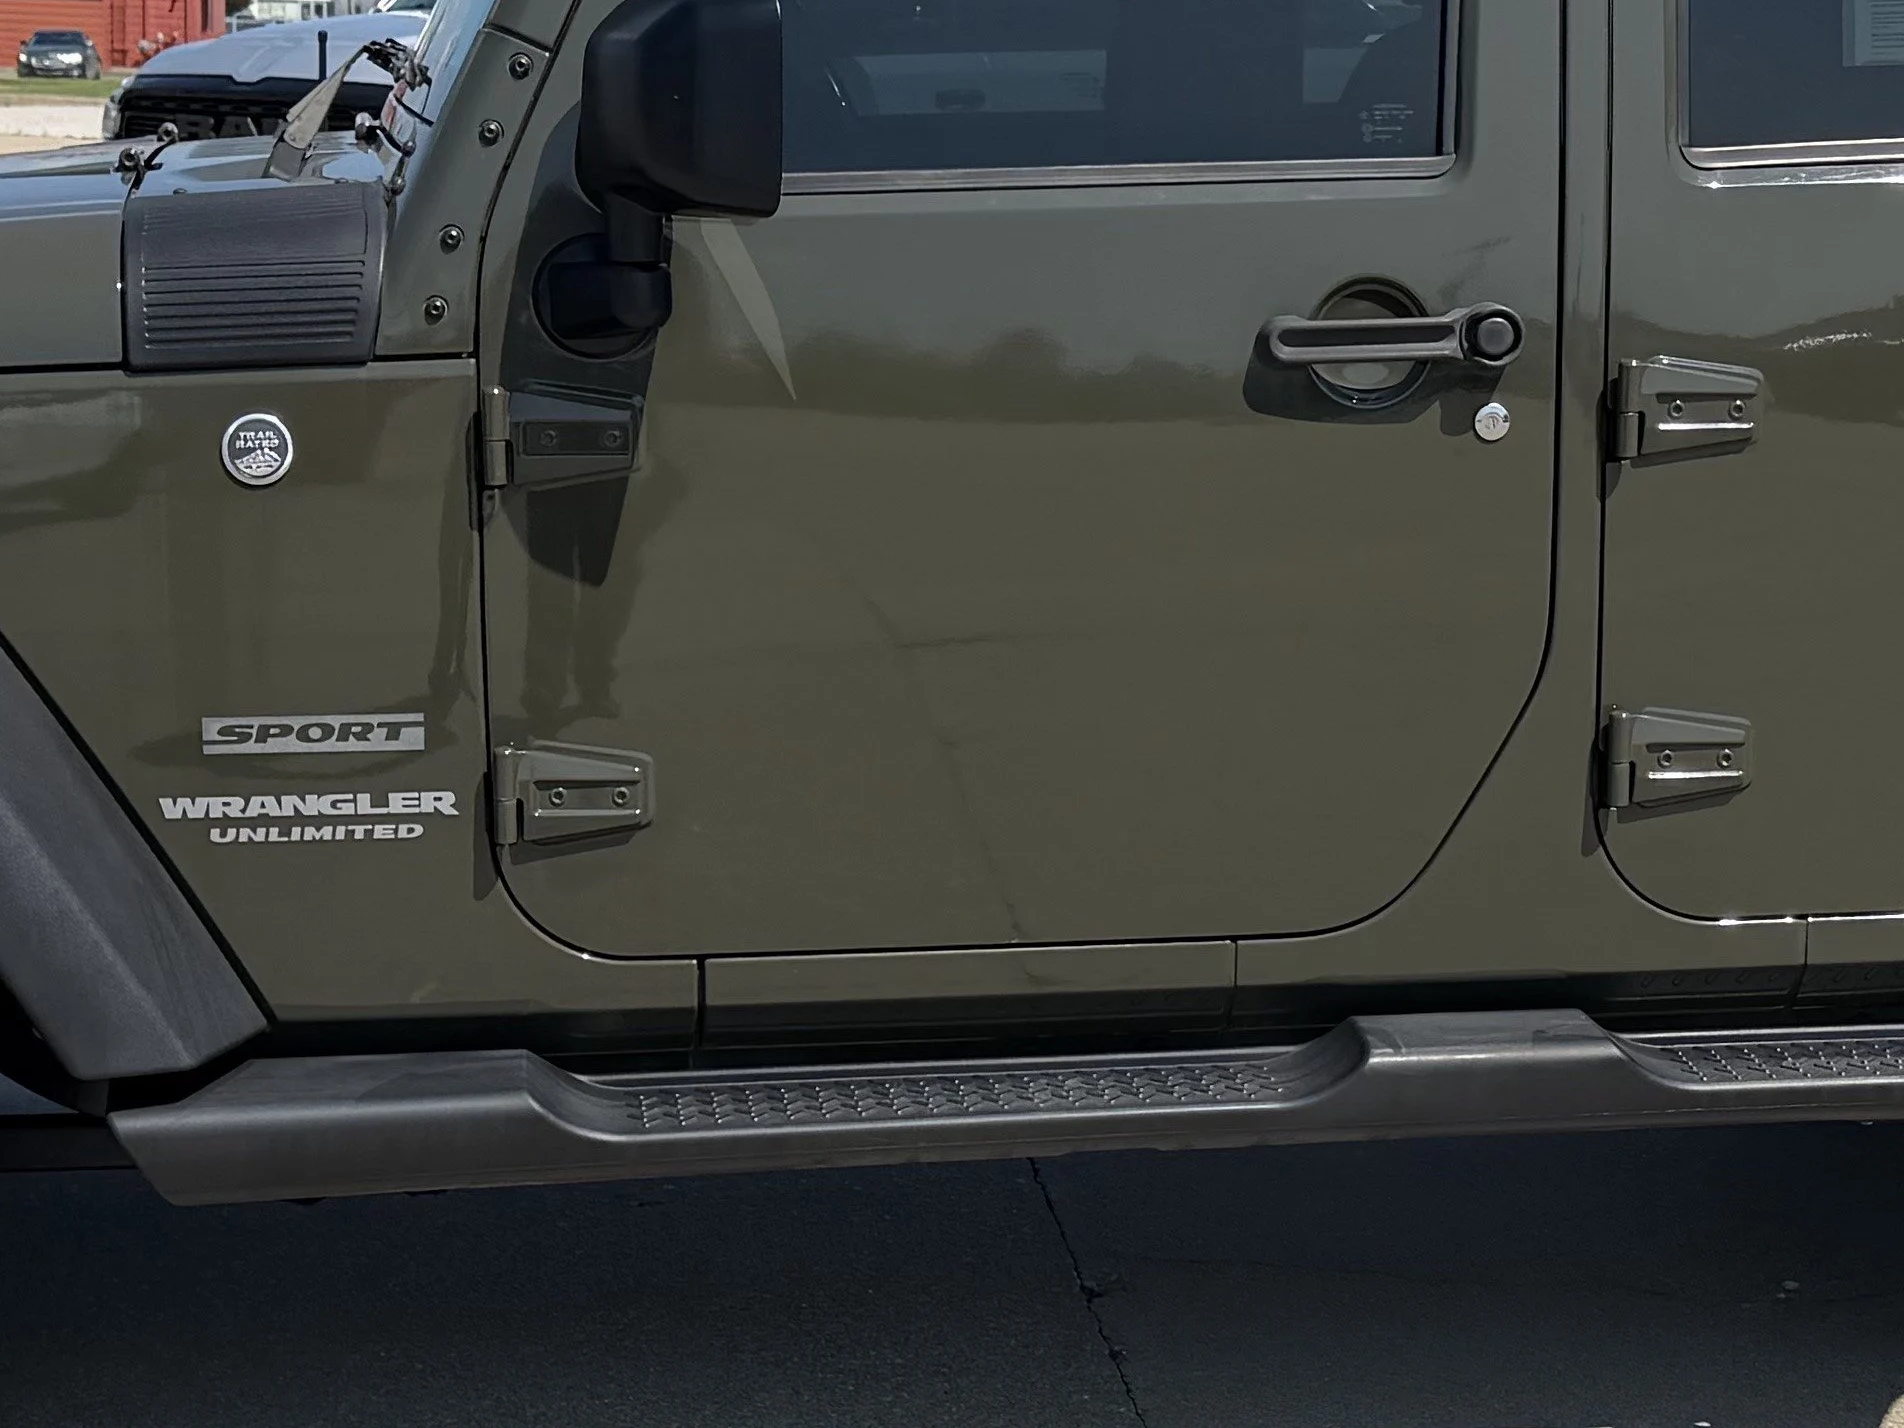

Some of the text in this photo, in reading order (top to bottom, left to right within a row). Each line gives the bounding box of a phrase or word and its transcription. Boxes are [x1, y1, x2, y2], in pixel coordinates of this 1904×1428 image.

[235, 438, 280, 449] RATED
[239, 430, 277, 440] TRAIL
[216, 721, 418, 744] SPORT
[158, 790, 460, 819] WRANGLER
[209, 823, 425, 843] UNLIMITED
